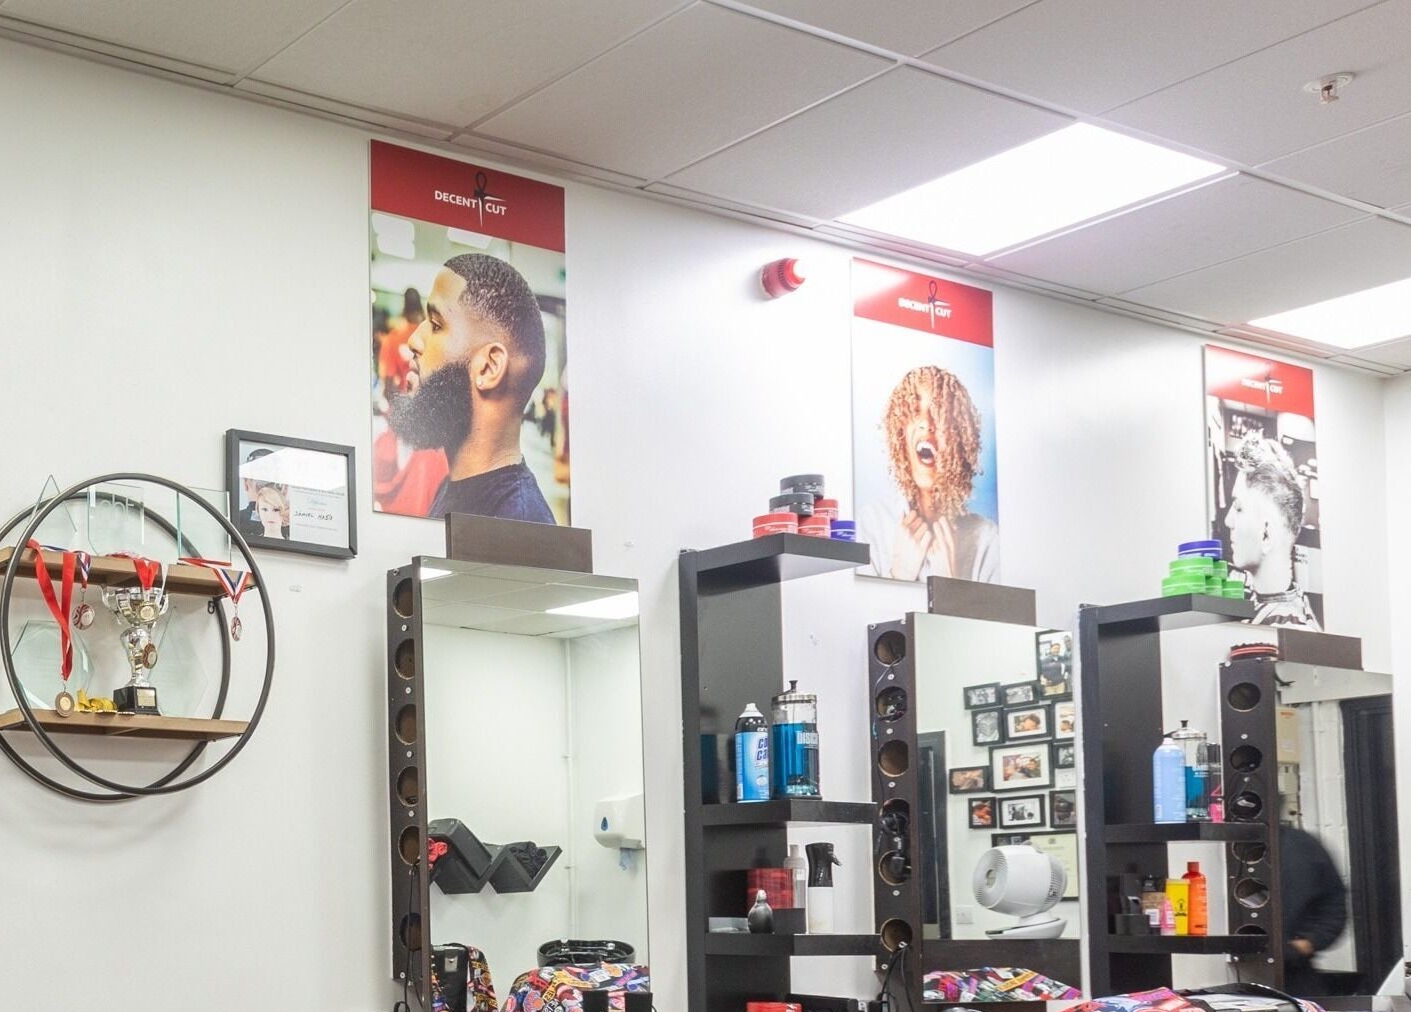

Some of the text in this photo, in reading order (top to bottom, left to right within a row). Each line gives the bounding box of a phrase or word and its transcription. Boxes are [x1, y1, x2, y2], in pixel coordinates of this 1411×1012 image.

[435, 190, 507, 216] DECENT CUT
[936, 306, 952, 318] CUT
